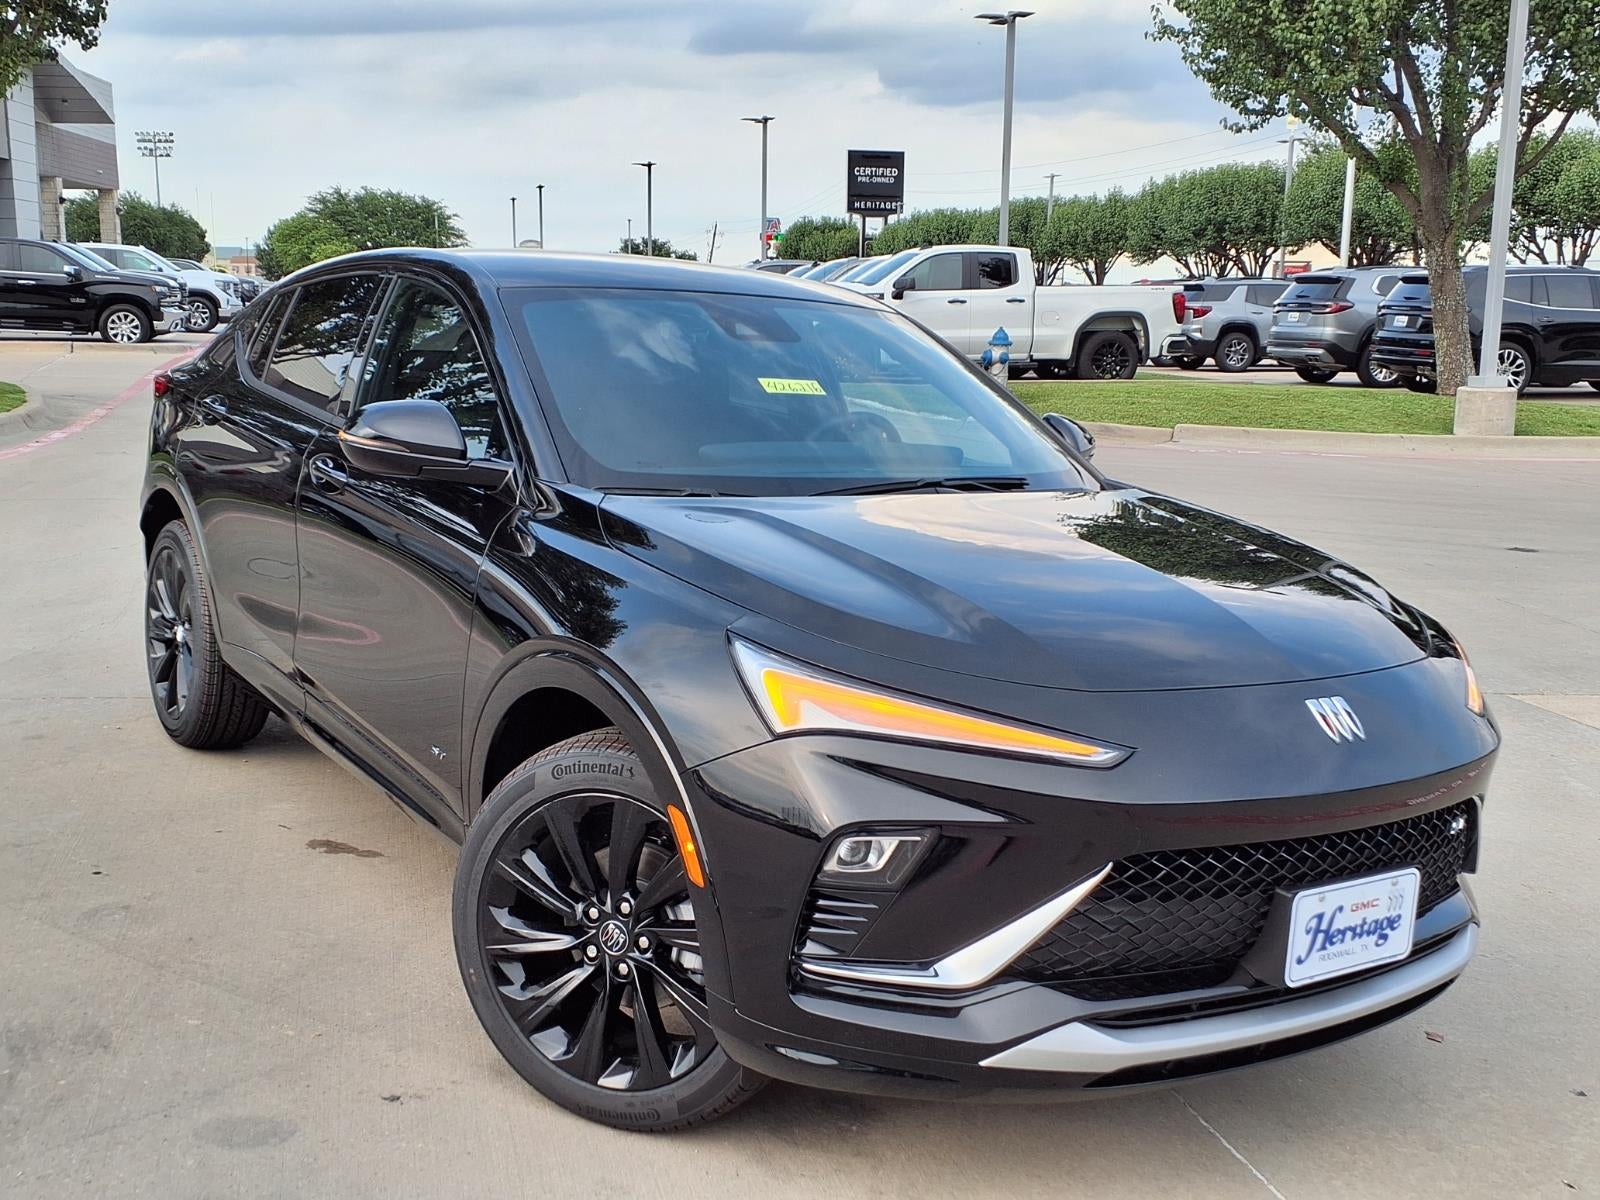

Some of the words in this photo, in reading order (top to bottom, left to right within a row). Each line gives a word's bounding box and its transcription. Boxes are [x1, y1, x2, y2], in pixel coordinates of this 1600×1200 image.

[854, 167, 899, 177] CERTIFIED
[857, 176, 895, 184] PRE-OWNED
[854, 201, 897, 209] HERITAGE
[551, 760, 624, 780] Continental
[1350, 898, 1380, 912] GMC
[1296, 905, 1402, 965] Heritage
